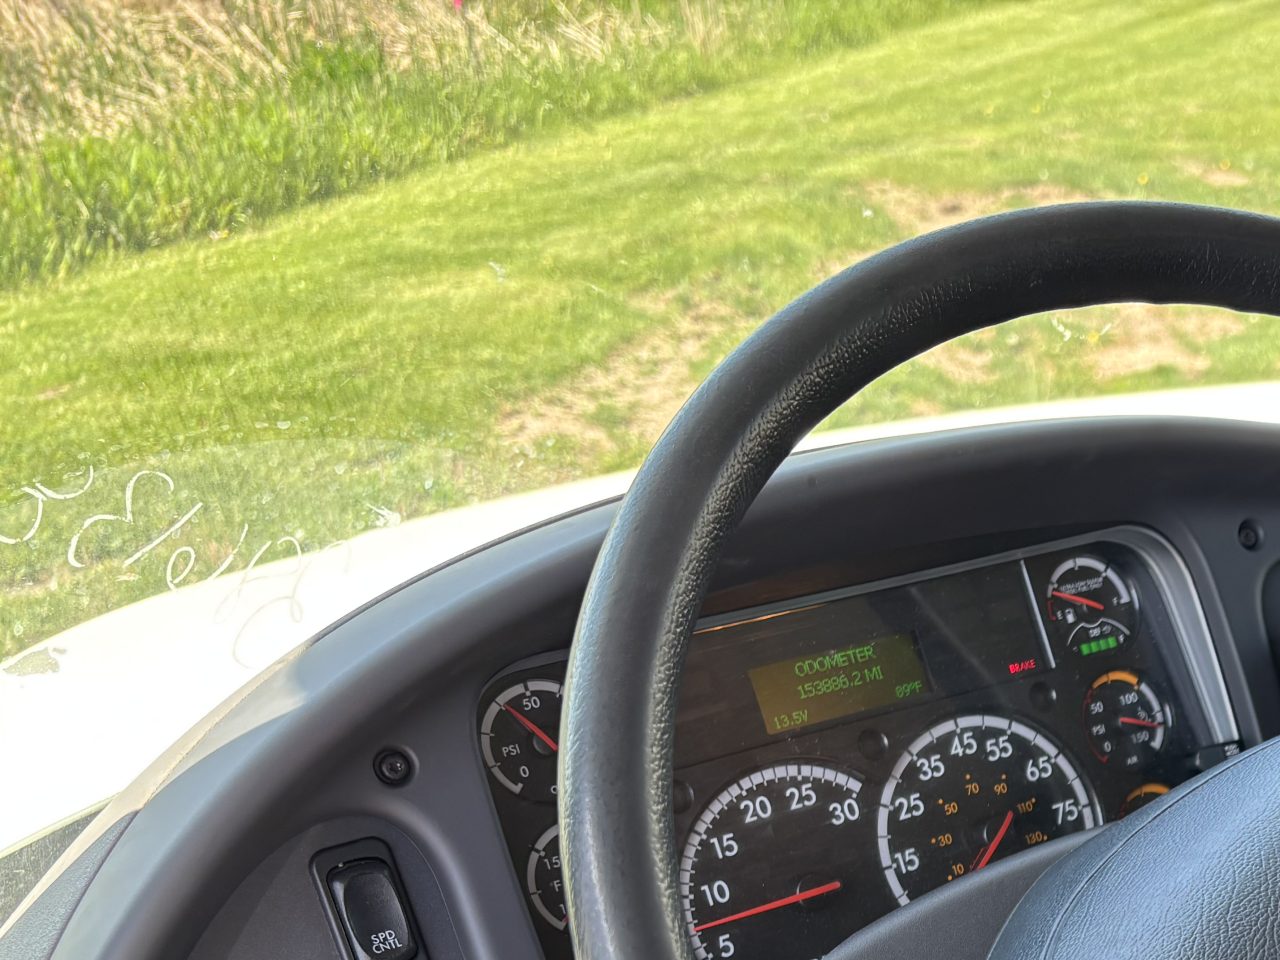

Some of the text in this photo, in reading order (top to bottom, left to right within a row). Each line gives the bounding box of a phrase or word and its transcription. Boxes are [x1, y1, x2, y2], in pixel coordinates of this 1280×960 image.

[794, 645, 875, 677] ODOMETER
[1009, 659, 1036, 674] BRAKE
[864, 665, 884, 682] MI
[523, 696, 540, 711] 50
[1120, 692, 1138, 706] 100
[1090, 701, 1104, 715] 50
[773, 709, 808, 730] 13.5V
[1092, 723, 1106, 736] PSI
[1131, 729, 1150, 744] 150
[502, 743, 520, 757] PSI
[950, 732, 978, 757] 45
[986, 735, 1013, 762] 55
[1104, 740, 1112, 753] 0
[520, 765, 530, 778] 0
[916, 754, 945, 782] 35
[1025, 756, 1053, 782] 65
[965, 782, 980, 796] 70
[993, 781, 1008, 795] 90
[785, 783, 817, 811] 25
[740, 795, 773, 824] 20
[828, 798, 860, 826] 30
[894, 793, 925, 821] 25
[944, 801, 958, 815] 50
[1016, 801, 1033, 815] 110
[1052, 798, 1079, 825] 75
[938, 833, 953, 847] 30
[1025, 831, 1043, 845] 130
[710, 833, 739, 860] 15
[544, 855, 562, 870] 15
[894, 847, 920, 874] 15
[952, 863, 965, 876] 10
[700, 880, 730, 906] 10
[371, 930, 396, 945] SPD
[372, 938, 403, 954] CNTL
[718, 934, 735, 958] 5
